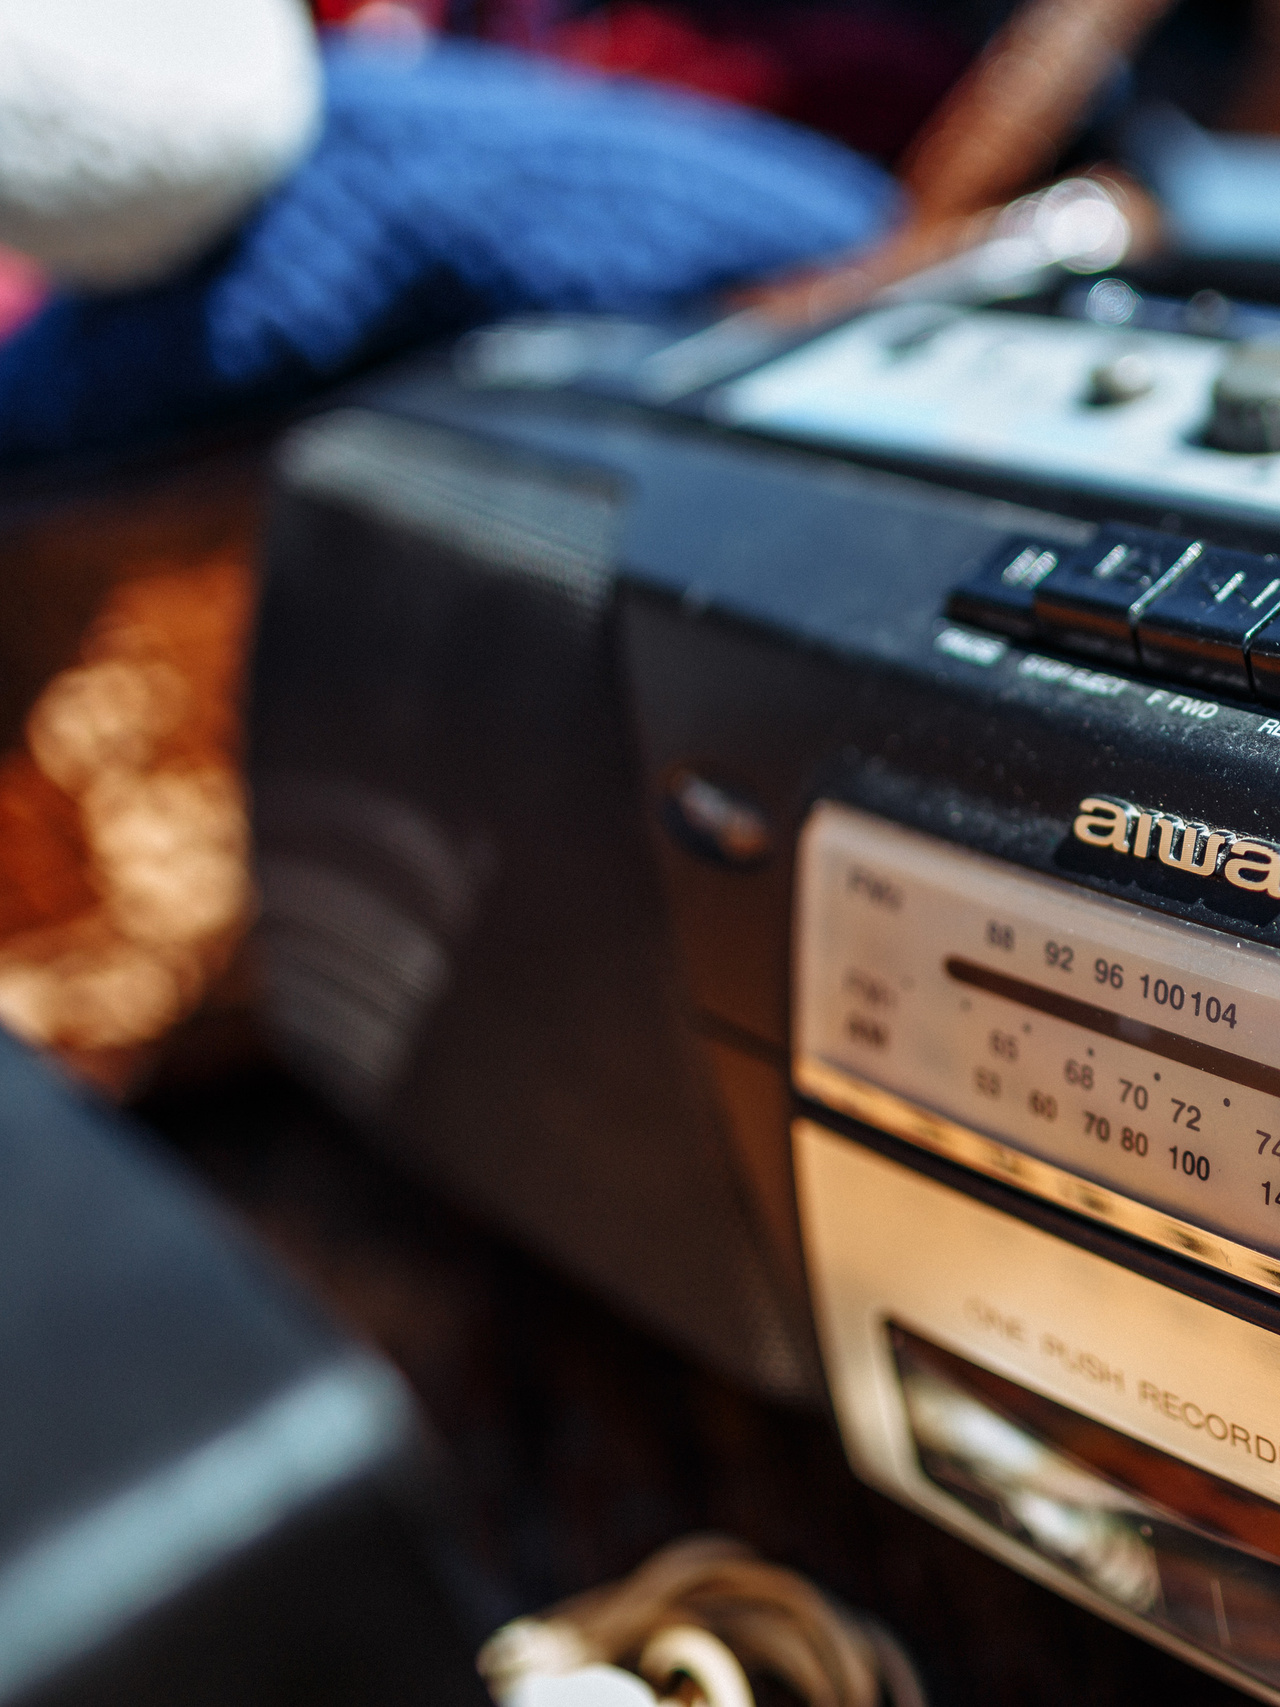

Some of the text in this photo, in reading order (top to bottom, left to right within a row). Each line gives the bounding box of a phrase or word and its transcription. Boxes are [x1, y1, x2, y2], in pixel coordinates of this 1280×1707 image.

[1146, 689, 1220, 720] F FWD
[1044, 940, 1075, 973] 92
[1094, 958, 1125, 990] 96
[1139, 974, 1186, 1011] 100
[1190, 992, 1238, 1030] 104
[1064, 1058, 1095, 1091] 68
[1118, 1078, 1149, 1111] 70
[1170, 1098, 1202, 1132] 72
[1082, 1110, 1111, 1143] 70
[1119, 1126, 1149, 1157] 80
[1168, 1145, 1211, 1182] 100
[1040, 1333, 1127, 1393] PUSH
